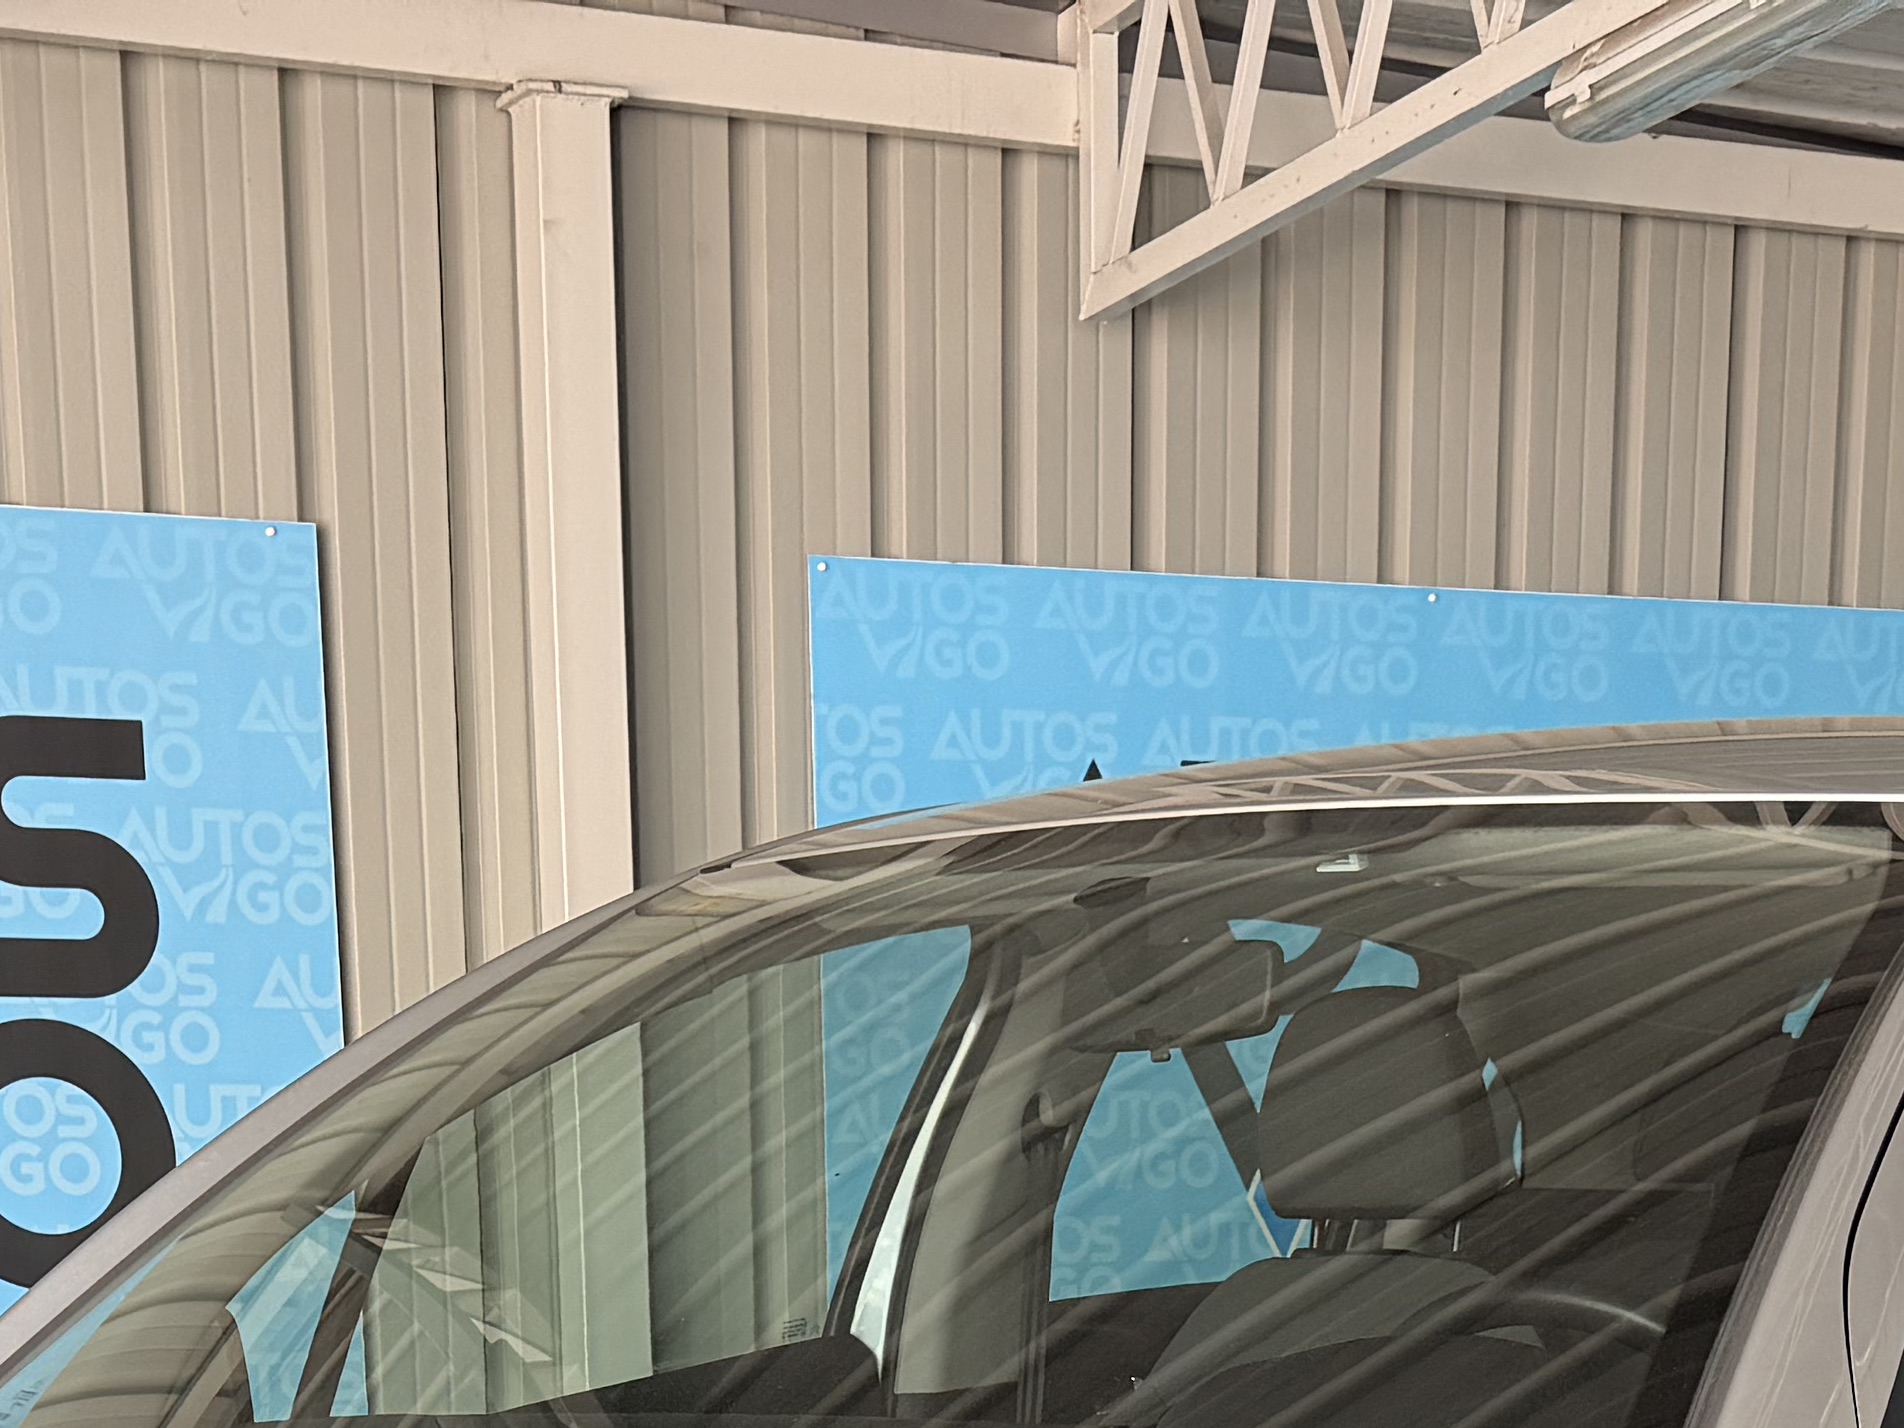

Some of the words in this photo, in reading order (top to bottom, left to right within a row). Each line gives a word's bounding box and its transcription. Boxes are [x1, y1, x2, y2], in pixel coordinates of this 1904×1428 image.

[815, 570, 1009, 628] AUTOS
[1034, 578, 1219, 637] AUTOS
[1240, 587, 1417, 645] AUTOS
[1440, 597, 1610, 651] AUTOS
[1631, 605, 1793, 658] AUTOS
